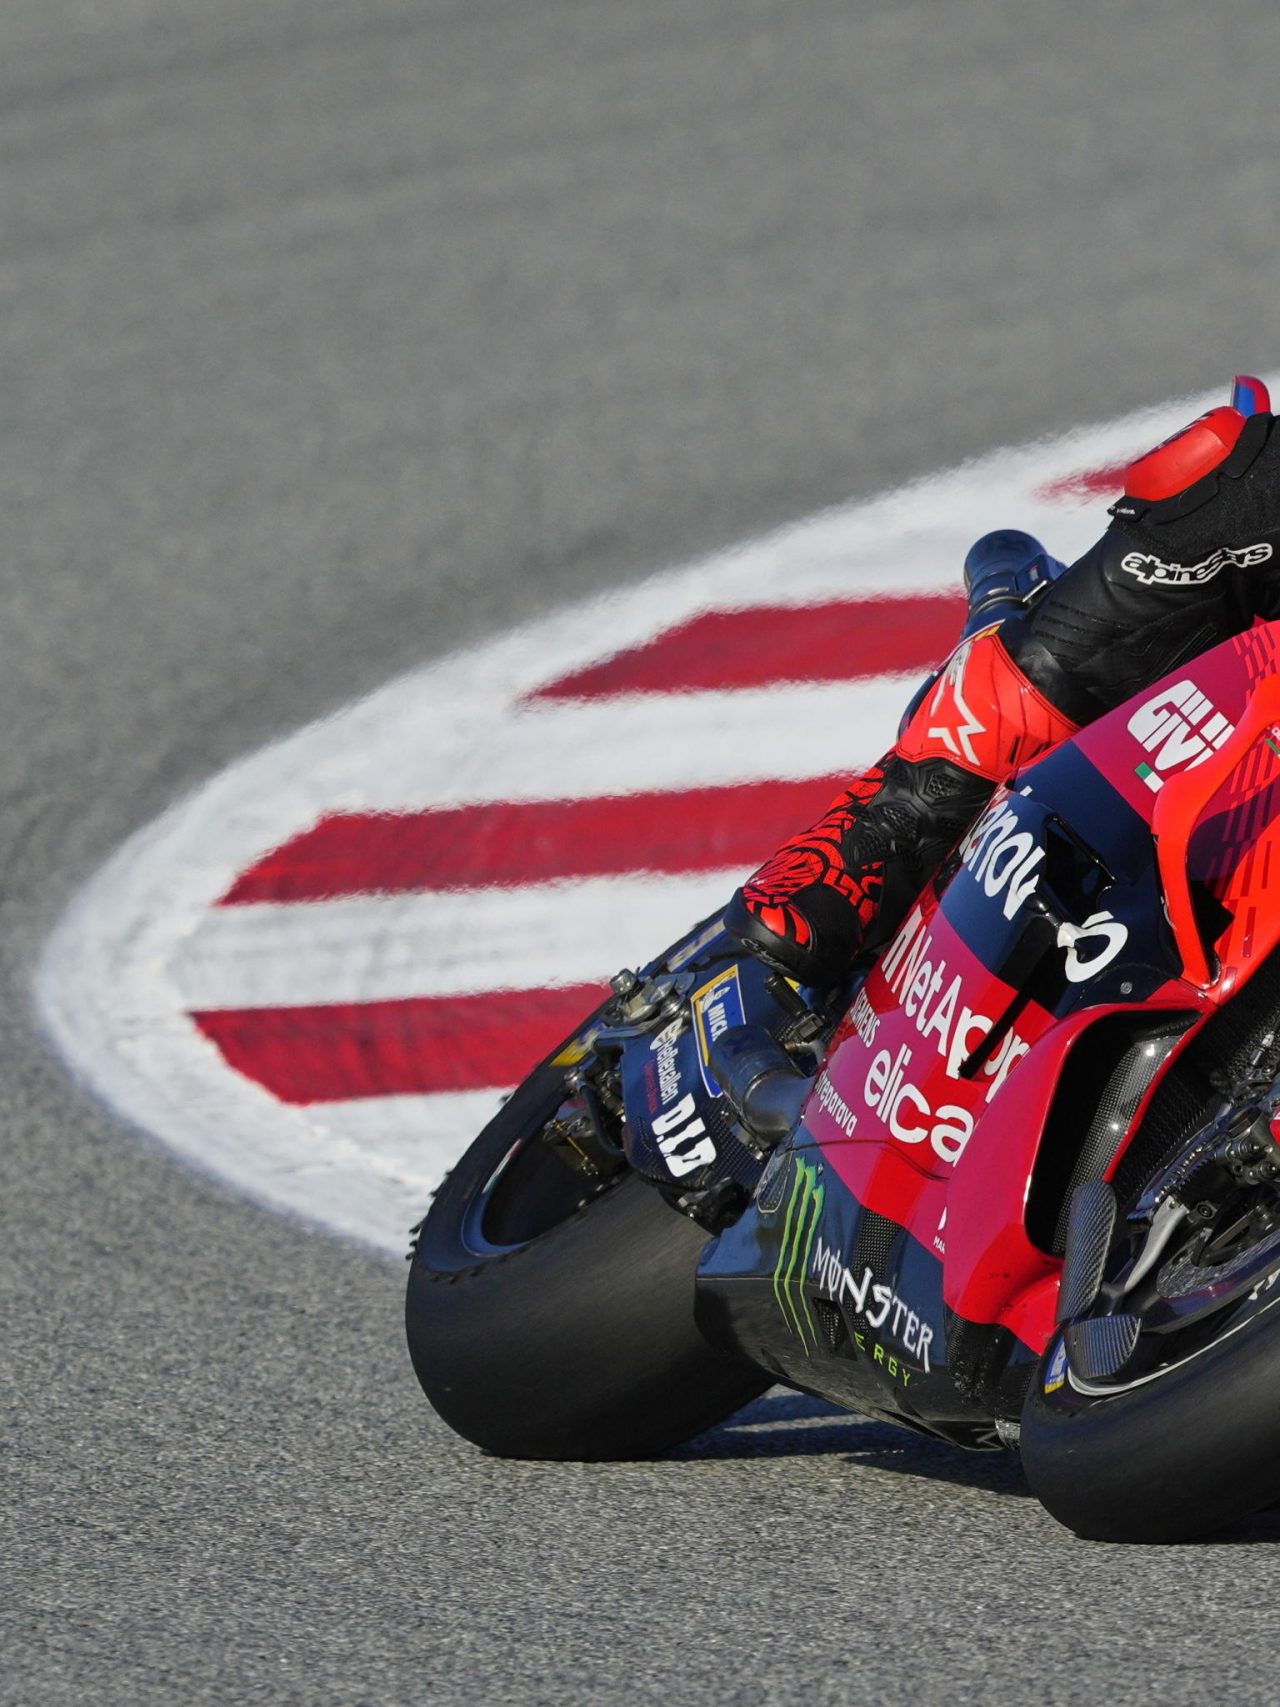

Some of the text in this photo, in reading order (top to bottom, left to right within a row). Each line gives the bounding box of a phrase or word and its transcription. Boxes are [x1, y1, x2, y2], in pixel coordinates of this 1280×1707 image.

[1121, 543, 1273, 585] alpinestars
[1126, 679, 1237, 771] GIVI
[850, 986, 881, 1049] SIEMENS
[864, 1043, 974, 1168] elica
